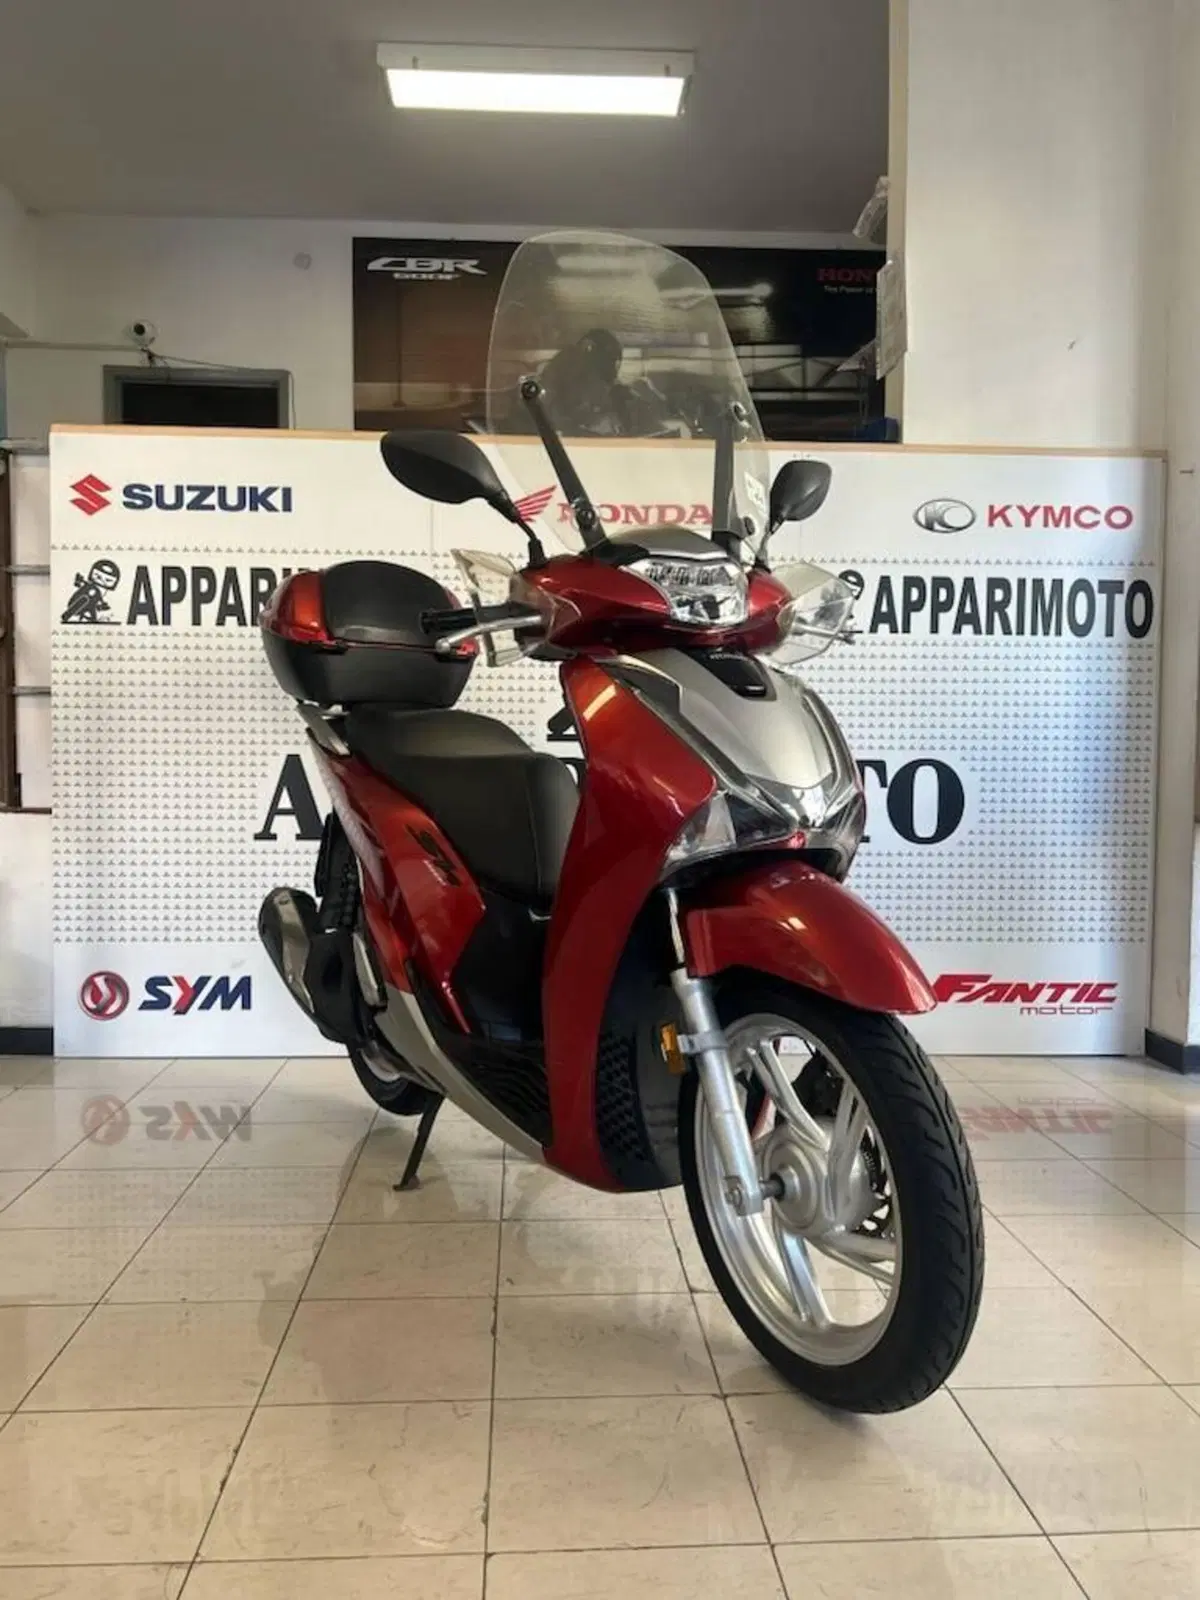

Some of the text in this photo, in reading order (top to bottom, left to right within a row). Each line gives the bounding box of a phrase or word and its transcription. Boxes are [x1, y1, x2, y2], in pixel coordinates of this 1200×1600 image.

[366, 257, 488, 275] CBR
[816, 267, 877, 282] HON
[122, 483, 293, 512] SUZUKI
[987, 505, 1133, 530] KYMCO
[126, 565, 318, 627] APPAR
[868, 575, 1154, 638] APPARIMOTO
[138, 975, 252, 1015] SYM
[931, 974, 1118, 1004] FANTIC
[1019, 1006, 1113, 1016] motor
